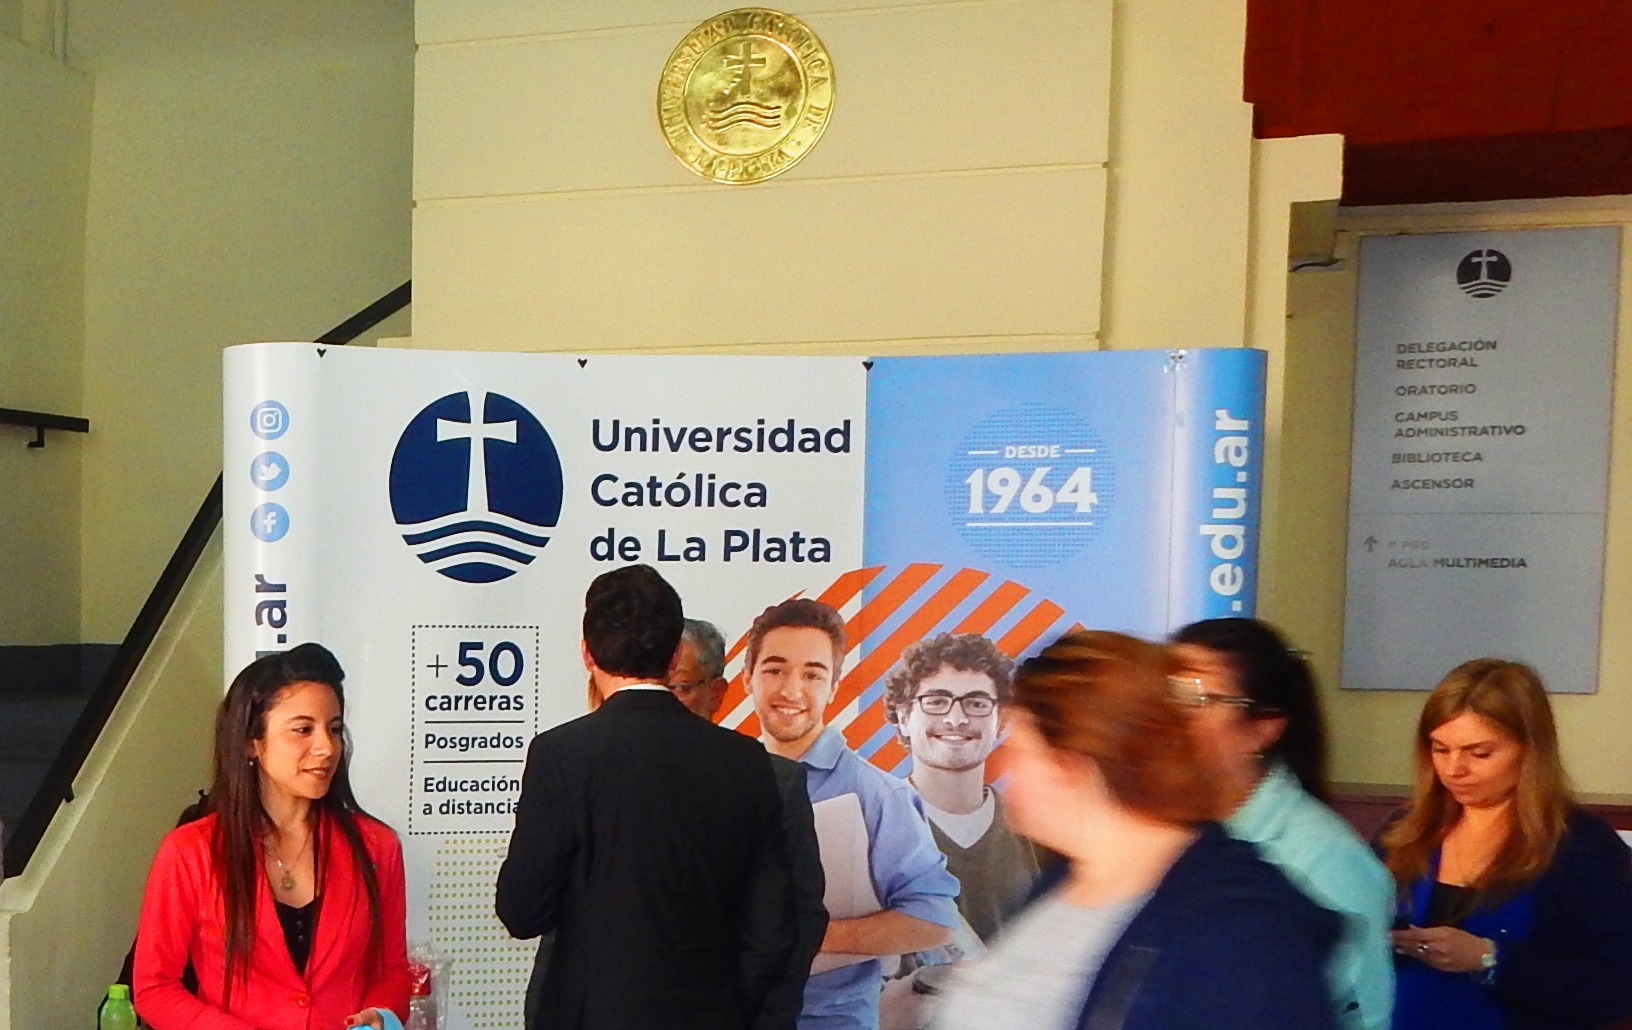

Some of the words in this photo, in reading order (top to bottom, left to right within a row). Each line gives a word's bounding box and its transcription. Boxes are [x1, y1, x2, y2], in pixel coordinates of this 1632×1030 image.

[1396, 338, 1498, 355] DELEGACIÓN
[1396, 357, 1479, 370] RECTORAL
[1394, 383, 1478, 397] ORATORIO
[1394, 410, 1459, 424] CAMPUS
[591, 418, 853, 455] Universidad
[1394, 424, 1527, 438] ADMINISTRATIVO
[1004, 444, 1061, 459] DESDE
[1391, 451, 1484, 464] BIBLIOTECA
[590, 472, 769, 508] Católica
[965, 465, 1098, 514] 1964
[1390, 478, 1475, 490] ASCENSOR
[590, 529, 642, 563] de
[656, 528, 707, 563] La
[722, 527, 832, 563] Plata
[1387, 557, 1429, 569] AULA
[1432, 557, 1528, 569] MULTIMEDIA
[425, 694, 524, 711] carreras
[424, 732, 524, 752] Posgrados
[423, 776, 520, 793] Educación
[422, 803, 433, 816] a
